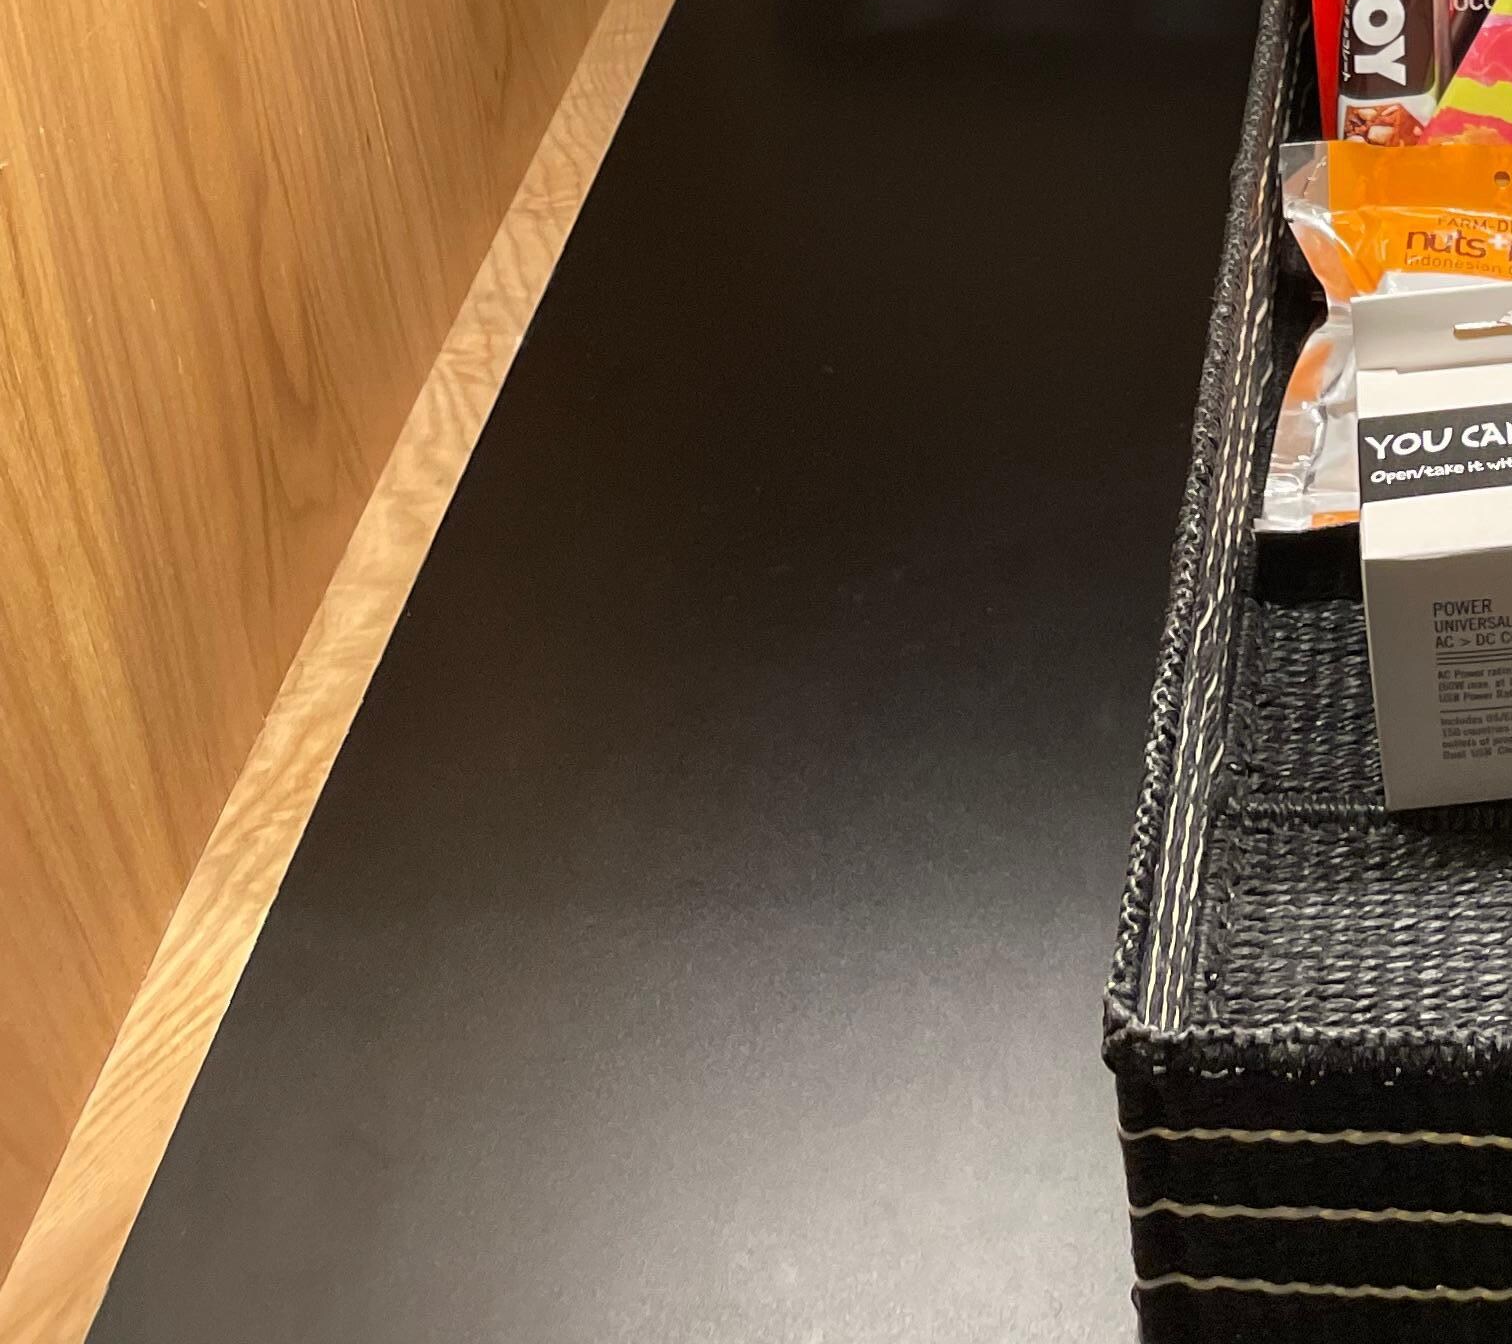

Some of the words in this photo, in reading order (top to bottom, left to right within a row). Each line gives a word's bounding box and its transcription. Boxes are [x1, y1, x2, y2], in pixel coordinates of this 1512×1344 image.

[1365, 427, 1453, 460] YOU
[1370, 464, 1464, 485] Open/take
[1467, 460, 1484, 474] it
[1433, 598, 1493, 618] POWER
[1434, 615, 1512, 634] UNIVERSAL
[1435, 635, 1454, 649] AC
[1476, 632, 1496, 647] DC
